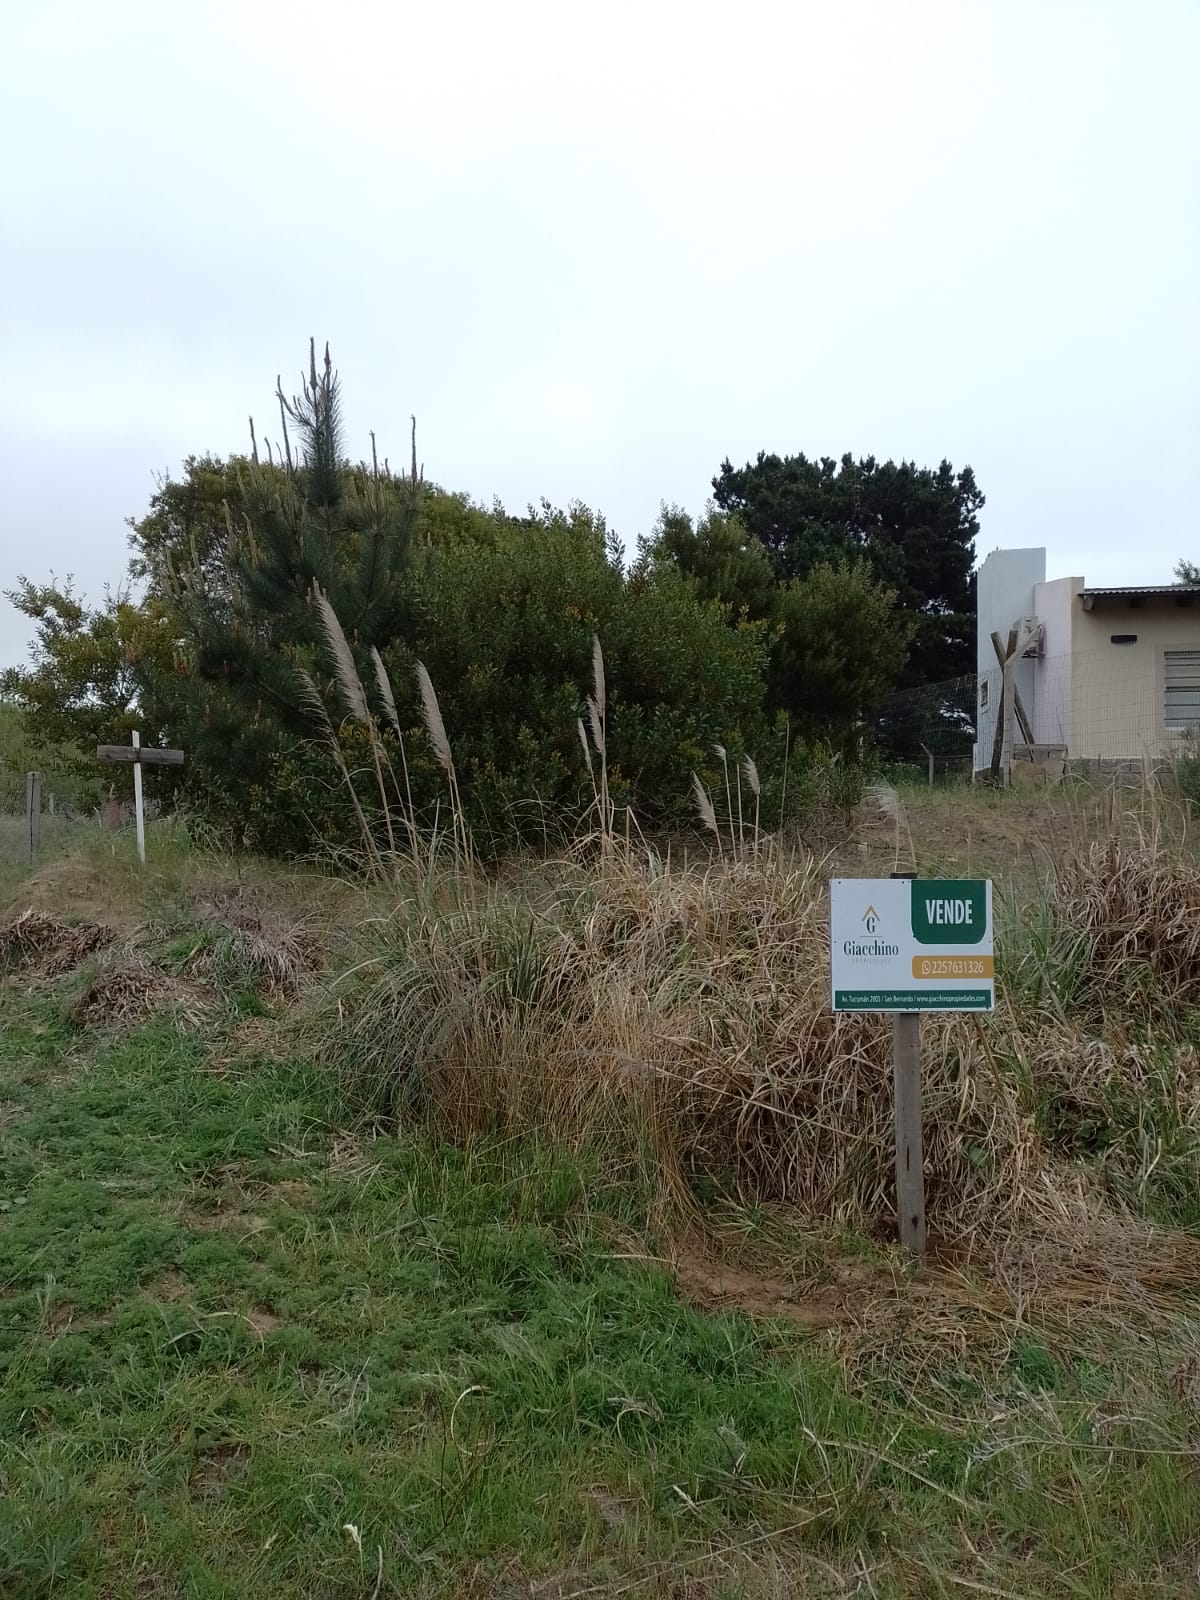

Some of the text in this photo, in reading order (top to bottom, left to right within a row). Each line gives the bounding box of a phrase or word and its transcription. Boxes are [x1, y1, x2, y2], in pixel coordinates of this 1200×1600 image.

[925, 899, 973, 925] VENDE
[866, 916, 875, 934] G
[843, 940, 899, 956] Giacchino
[931, 960, 984, 974] 2257631326
[884, 995, 893, 1003] San
[893, 995, 914, 1003] Bernardo
